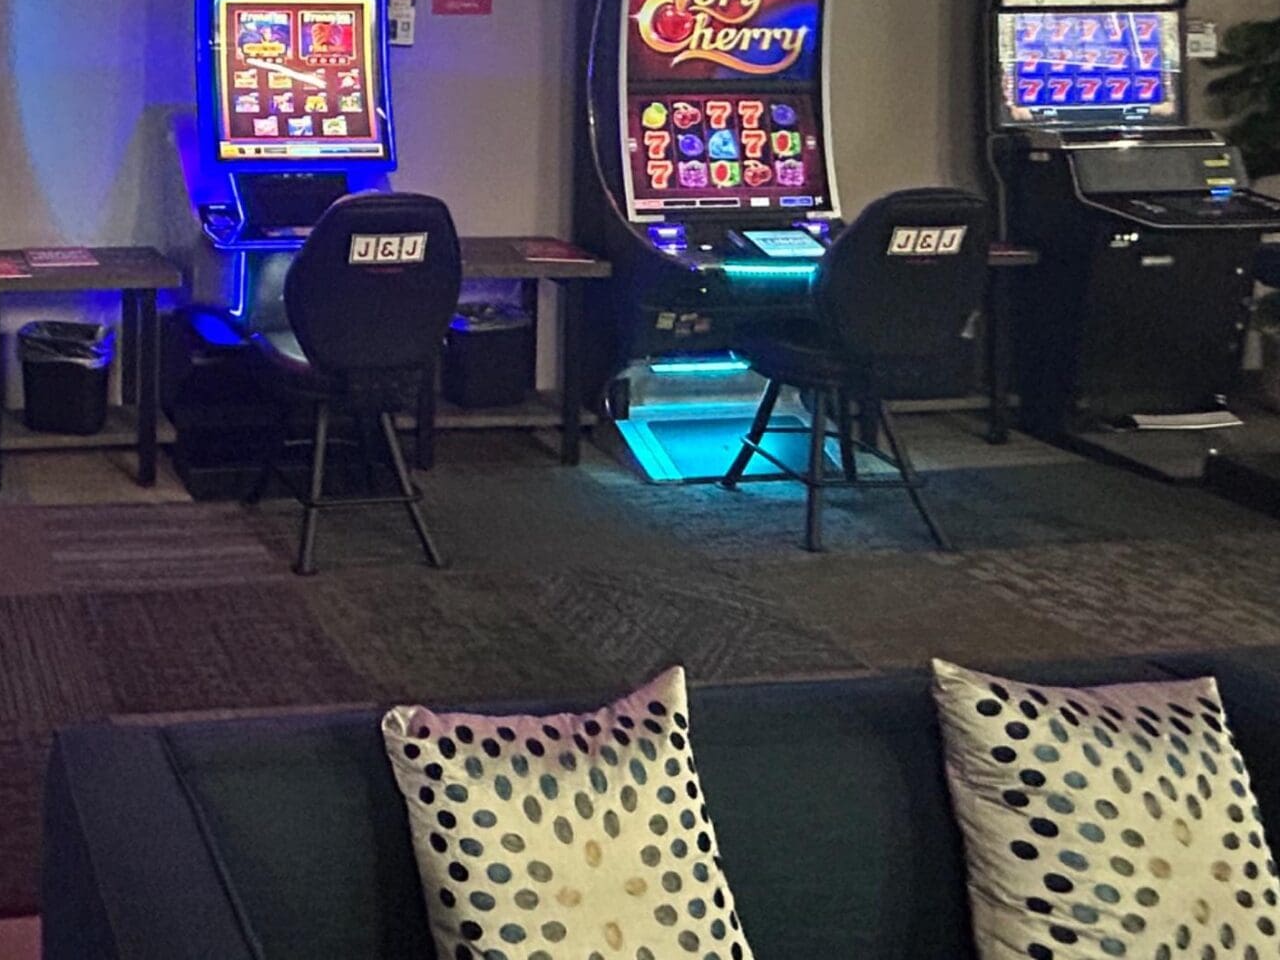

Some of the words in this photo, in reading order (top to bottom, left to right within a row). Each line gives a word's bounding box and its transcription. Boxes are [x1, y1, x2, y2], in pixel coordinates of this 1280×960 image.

[706, 101, 732, 129] 7
[738, 101, 764, 129] 7
[644, 130, 671, 159] 7
[741, 130, 767, 158] 7
[647, 160, 673, 189] 7
